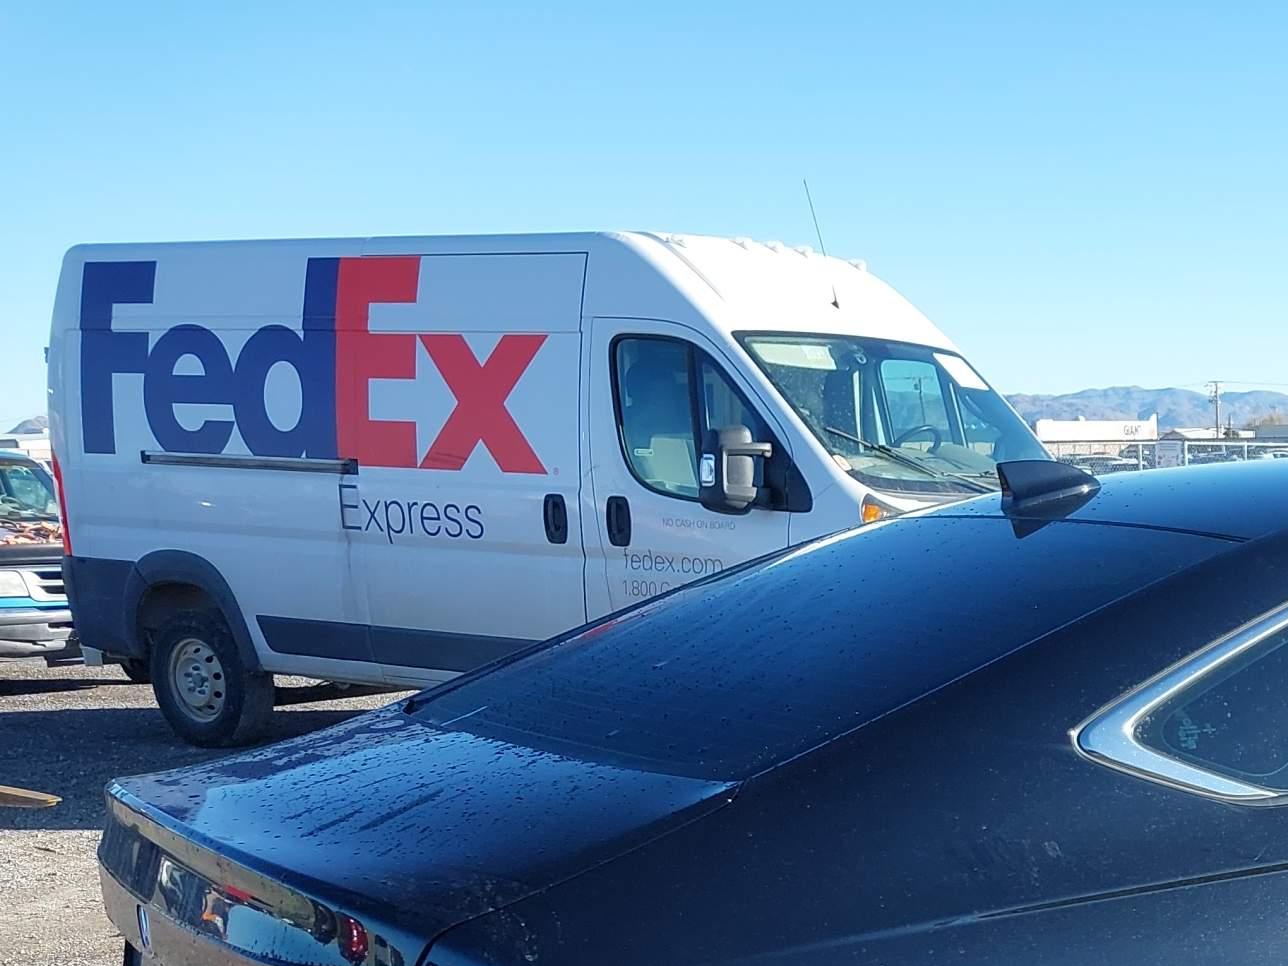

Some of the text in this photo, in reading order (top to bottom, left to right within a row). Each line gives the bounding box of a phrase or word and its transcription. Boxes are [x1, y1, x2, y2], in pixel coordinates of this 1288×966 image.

[80, 256, 548, 475] FedEx
[340, 484, 485, 544] Express
[662, 517, 736, 531] NO CASH ON BOARD
[623, 547, 724, 575] fedex.com
